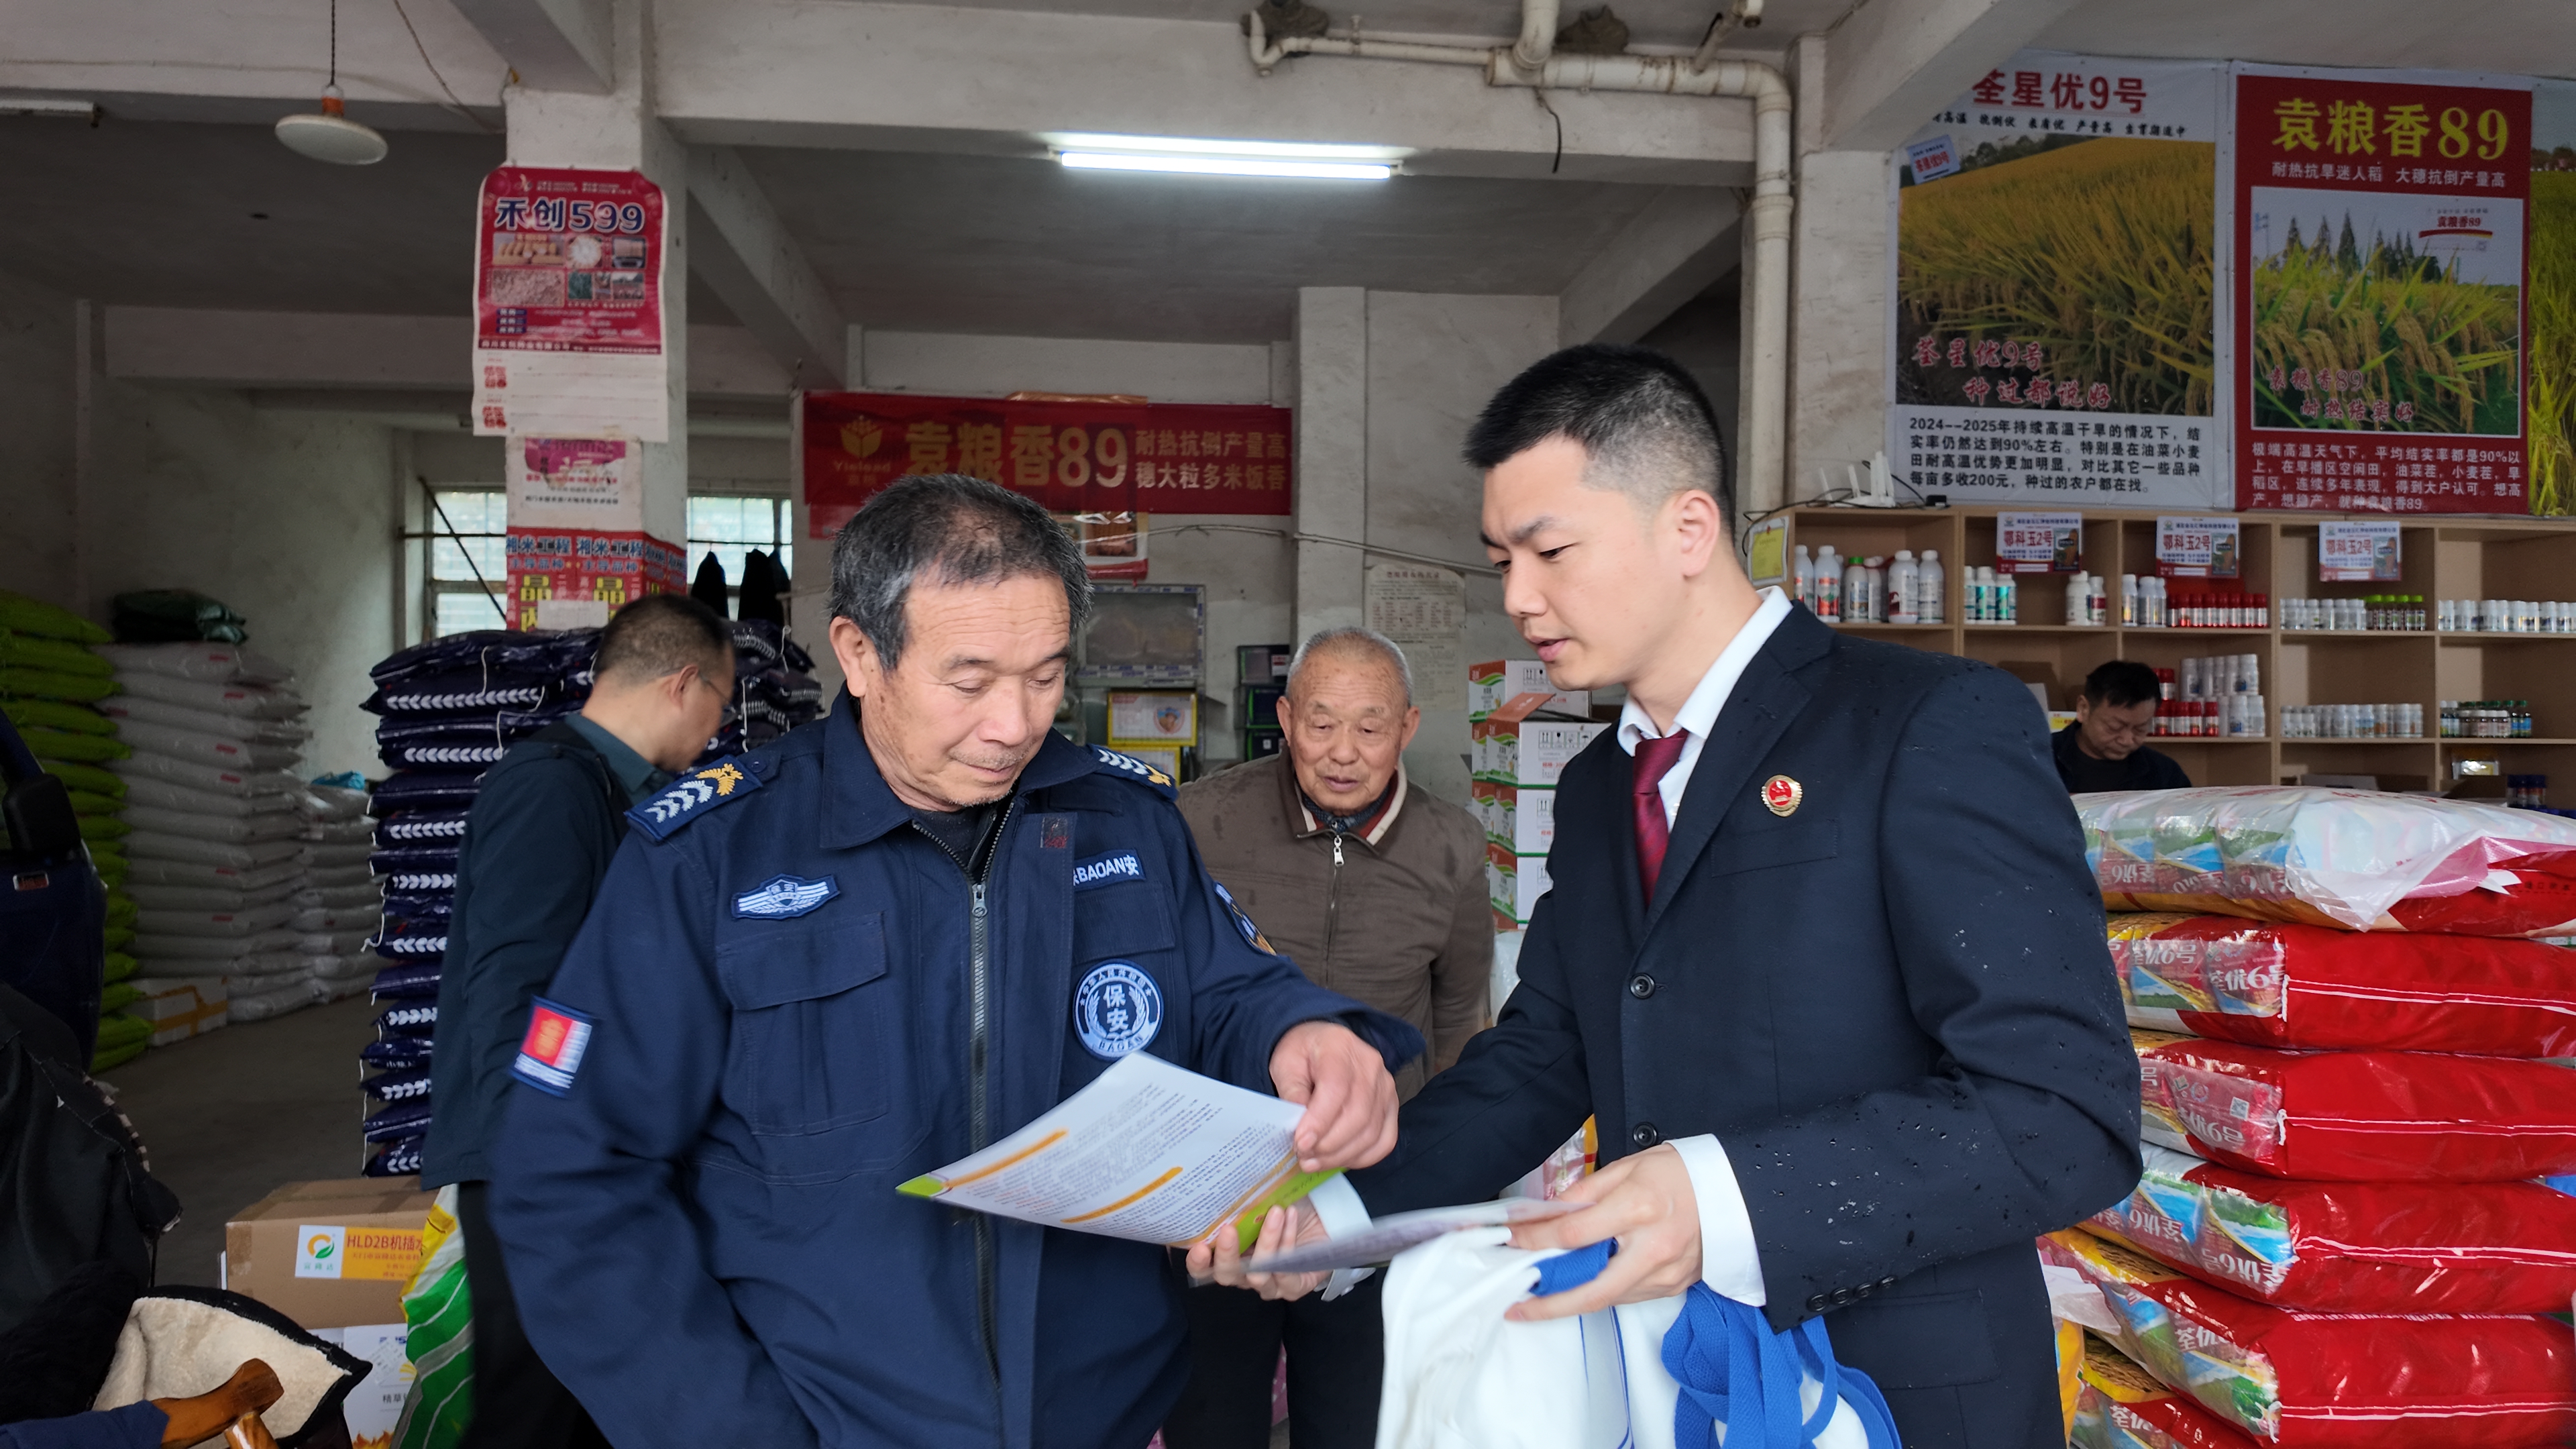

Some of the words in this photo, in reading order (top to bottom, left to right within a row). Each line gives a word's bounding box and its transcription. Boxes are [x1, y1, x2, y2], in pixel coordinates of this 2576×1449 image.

[2271, 98, 2508, 160] 袁粮香89
[494, 197, 644, 233] 禾创599
[1963, 377, 2112, 409] 种过都说好
[2267, 365, 2364, 392] 袁粮香89
[906, 421, 1128, 488] 袁粮香89
[1136, 429, 1285, 459] 耐热抗倒产量高
[1136, 461, 1285, 490] 穗大粒多米饭香
[1102, 983, 1129, 1033] 保安
